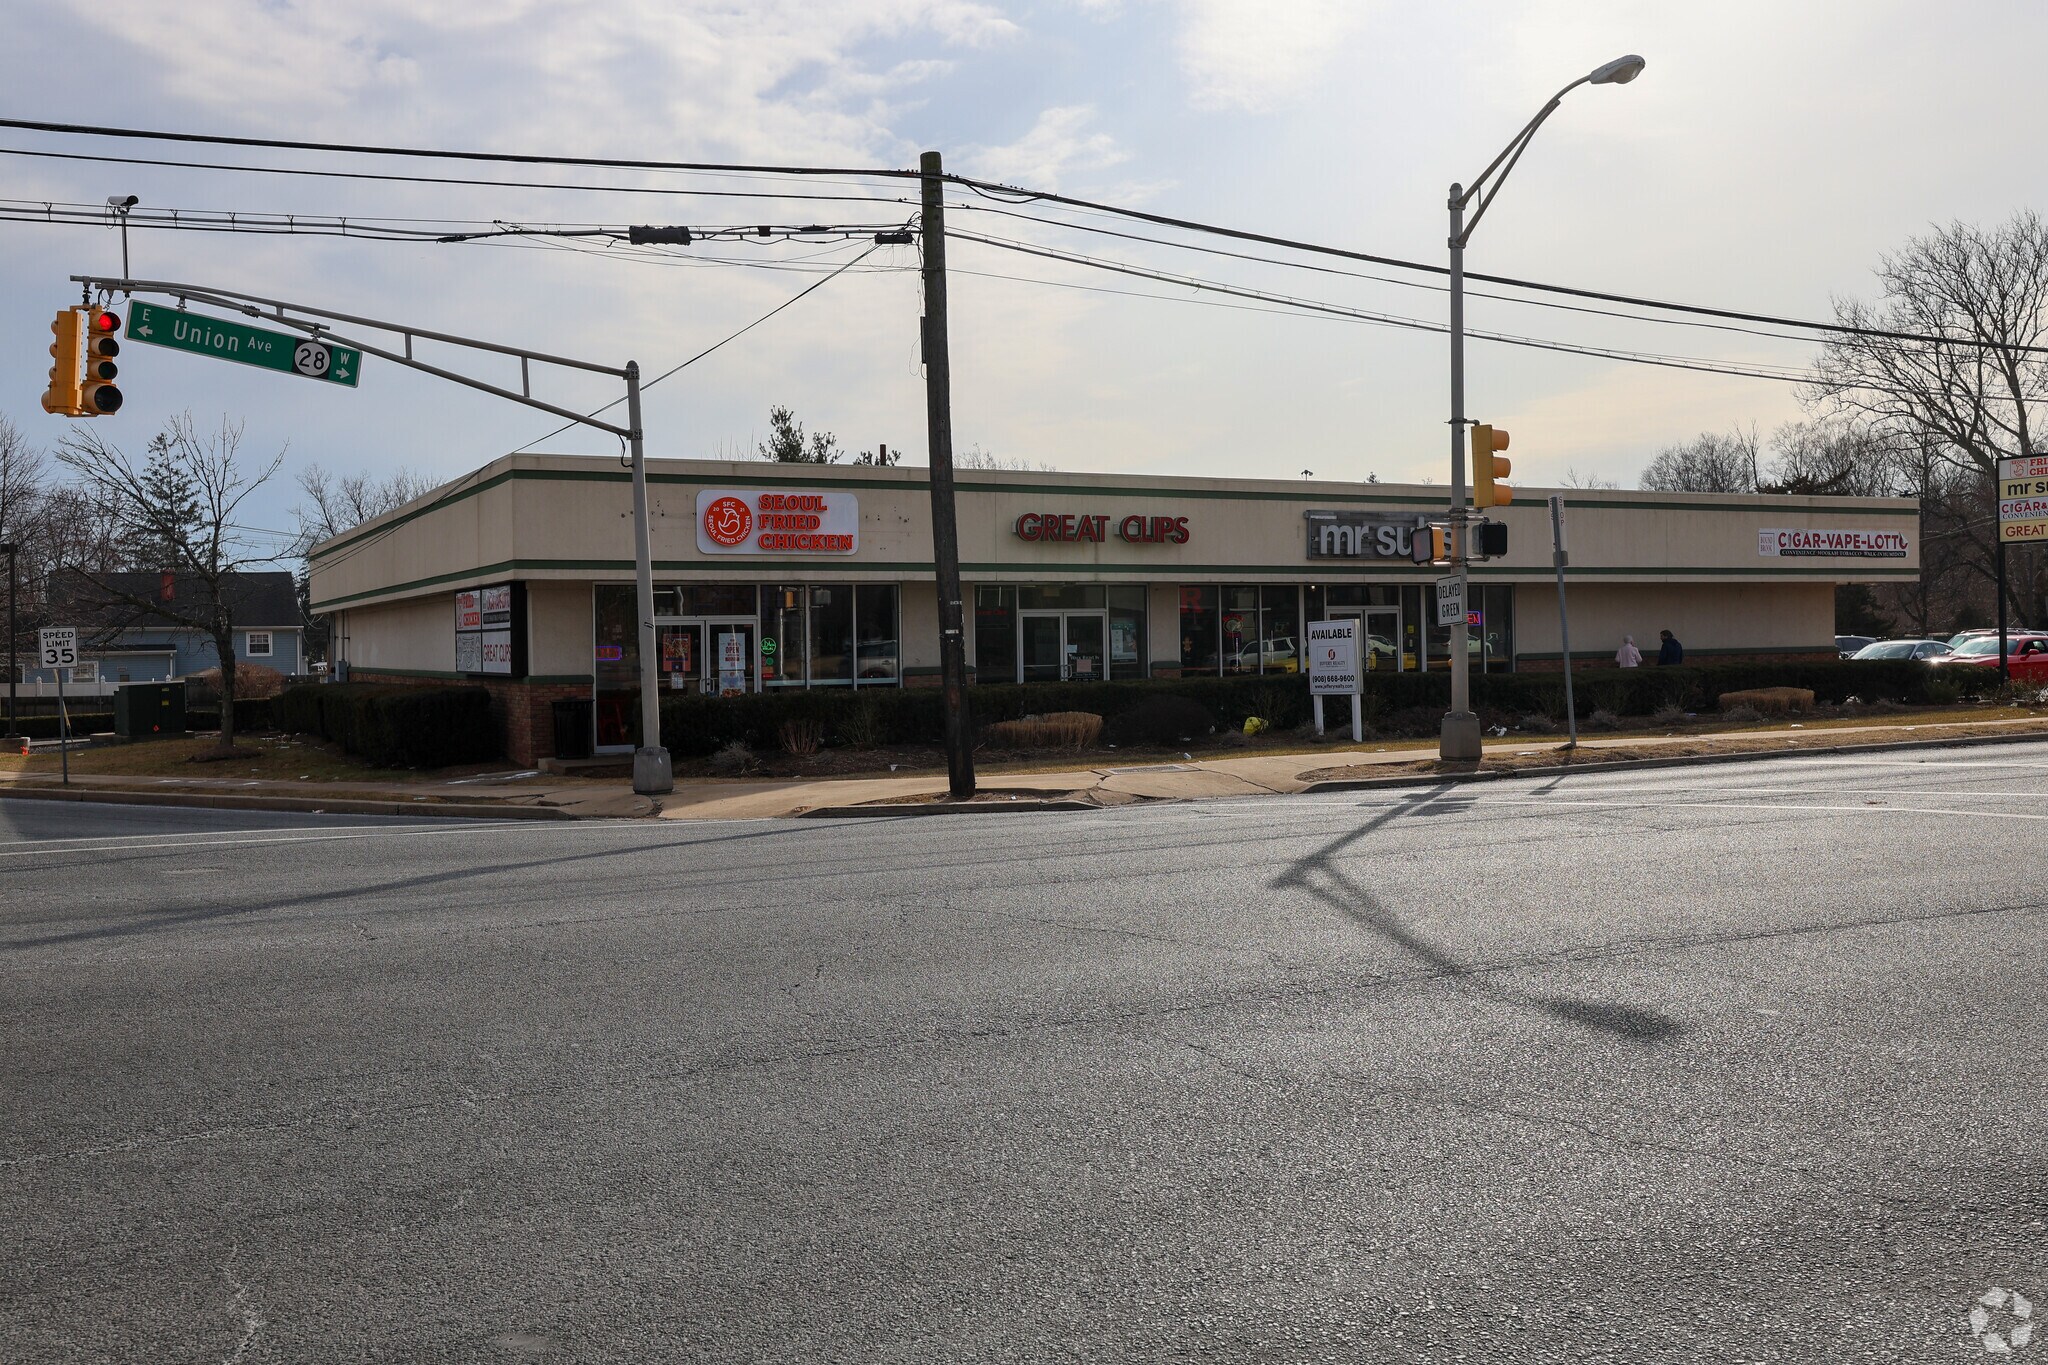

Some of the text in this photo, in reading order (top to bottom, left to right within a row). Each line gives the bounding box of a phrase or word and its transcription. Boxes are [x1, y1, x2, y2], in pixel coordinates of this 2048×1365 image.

[142, 308, 151, 322] E
[173, 320, 272, 352] Union Ave
[298, 348, 325, 370] 28
[340, 353, 350, 365] W
[2008, 482, 2048, 496] mr s
[758, 494, 827, 512] SEOUL
[708, 515, 751, 543] SEOUL FRIED CHICKEN
[758, 514, 820, 530] FRIED
[1016, 512, 1190, 544] GREAT CLIPS
[1320, 516, 1452, 556] mr su
[2006, 524, 2046, 537] GREAT
[758, 534, 853, 550] CHICKEN
[1439, 582, 1460, 599] DELAYED
[1442, 602, 1460, 618] GREEN
[42, 631, 74, 639] SPEED
[1312, 628, 1352, 640] AVAILABLE
[46, 649, 74, 664] 35
[484, 644, 511, 662] GREAT CLIPS
